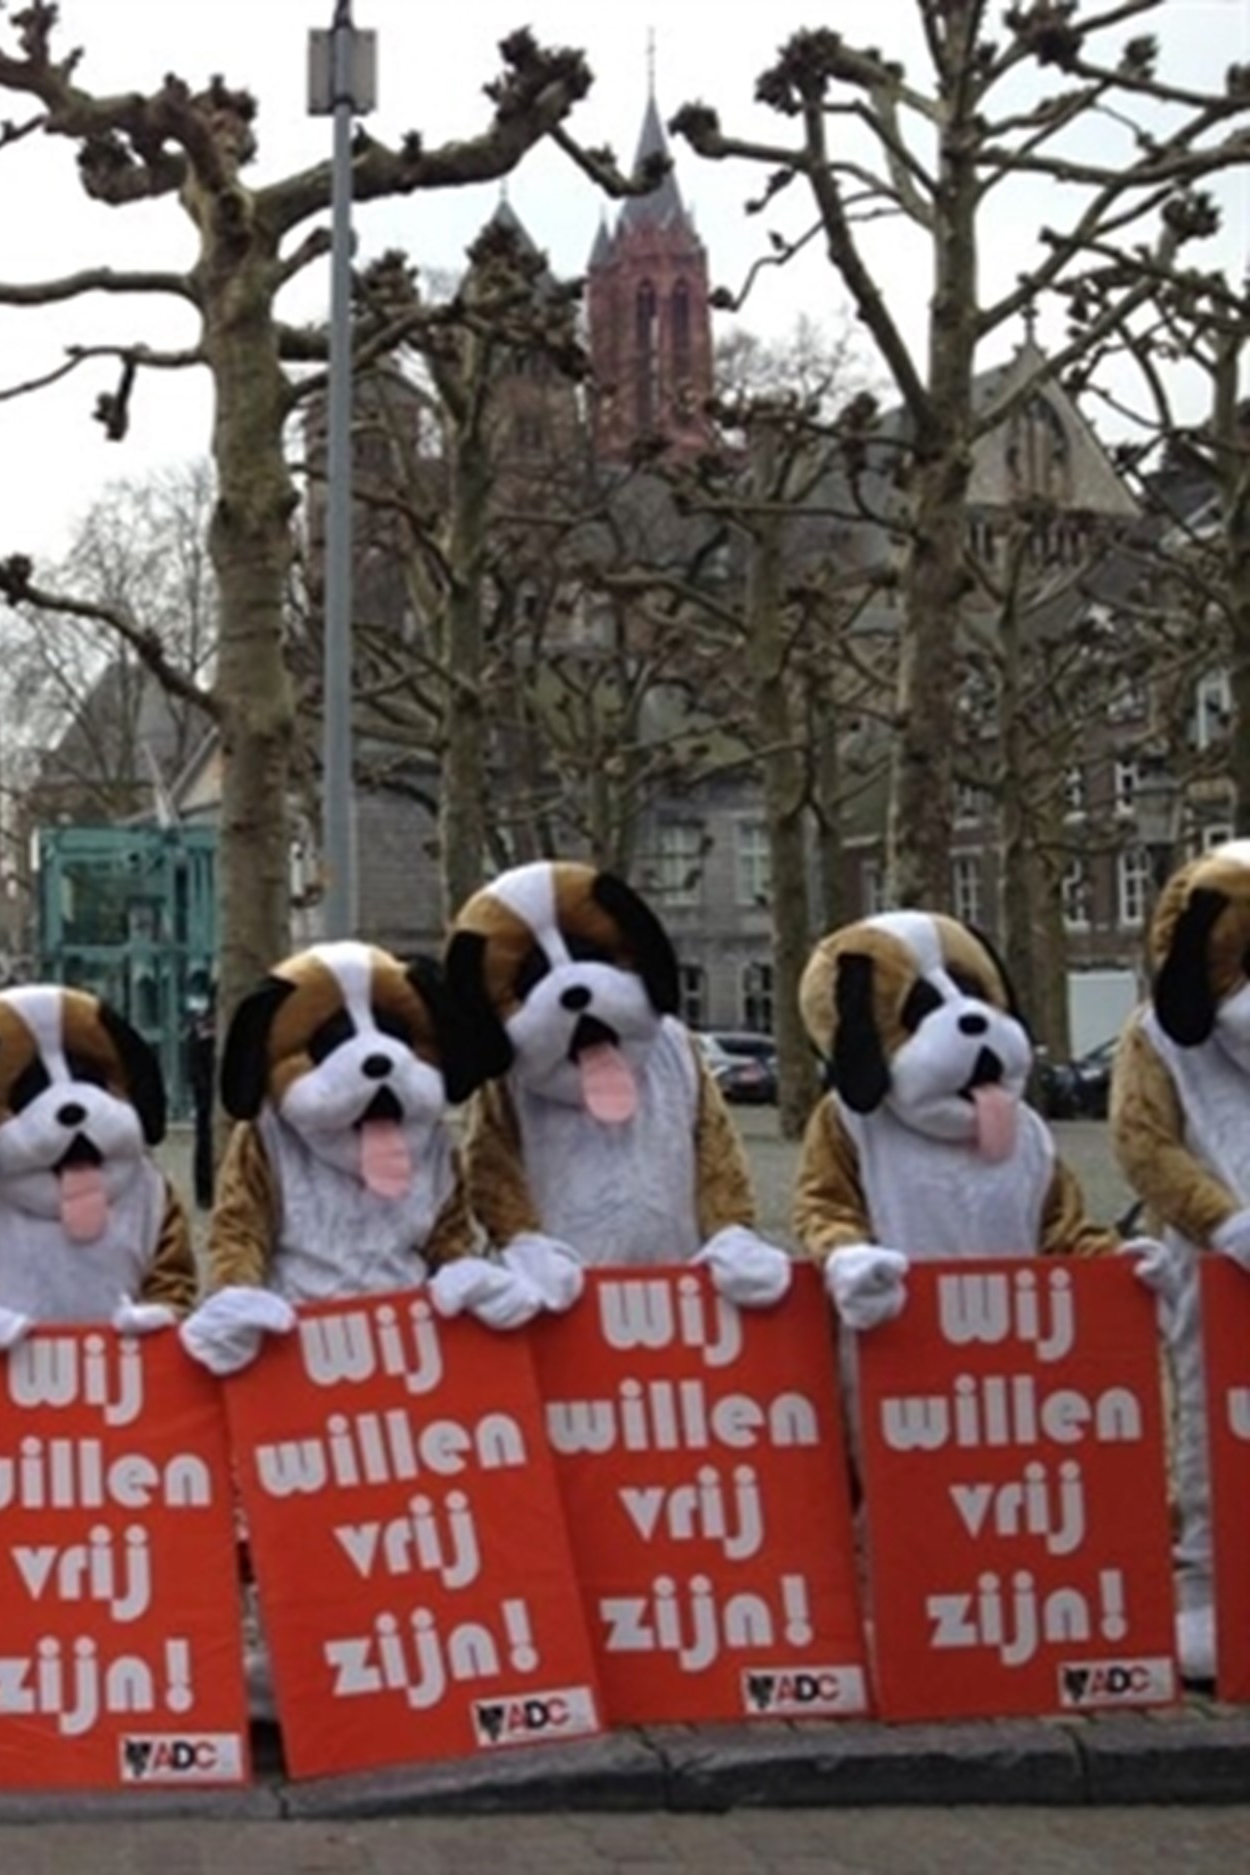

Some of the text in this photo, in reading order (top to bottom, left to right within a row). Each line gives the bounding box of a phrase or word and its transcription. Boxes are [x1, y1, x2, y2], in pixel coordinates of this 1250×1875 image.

[300, 1299, 444, 1395] Wij
[597, 1274, 742, 1367] Wij
[937, 1267, 1074, 1362] Wij
[7, 1333, 144, 1427] Wij
[546, 1377, 818, 1454] willen
[881, 1374, 1141, 1451] willen
[254, 1408, 527, 1498] willen
[333, 1489, 481, 1590] vrij
[618, 1464, 764, 1561] vrij
[949, 1460, 1084, 1555] vrij
[10, 1523, 152, 1623] vrij
[926, 1569, 1126, 1666] zijn!
[323, 1598, 539, 1710] zijn!
[599, 1574, 813, 1672] zijn!
